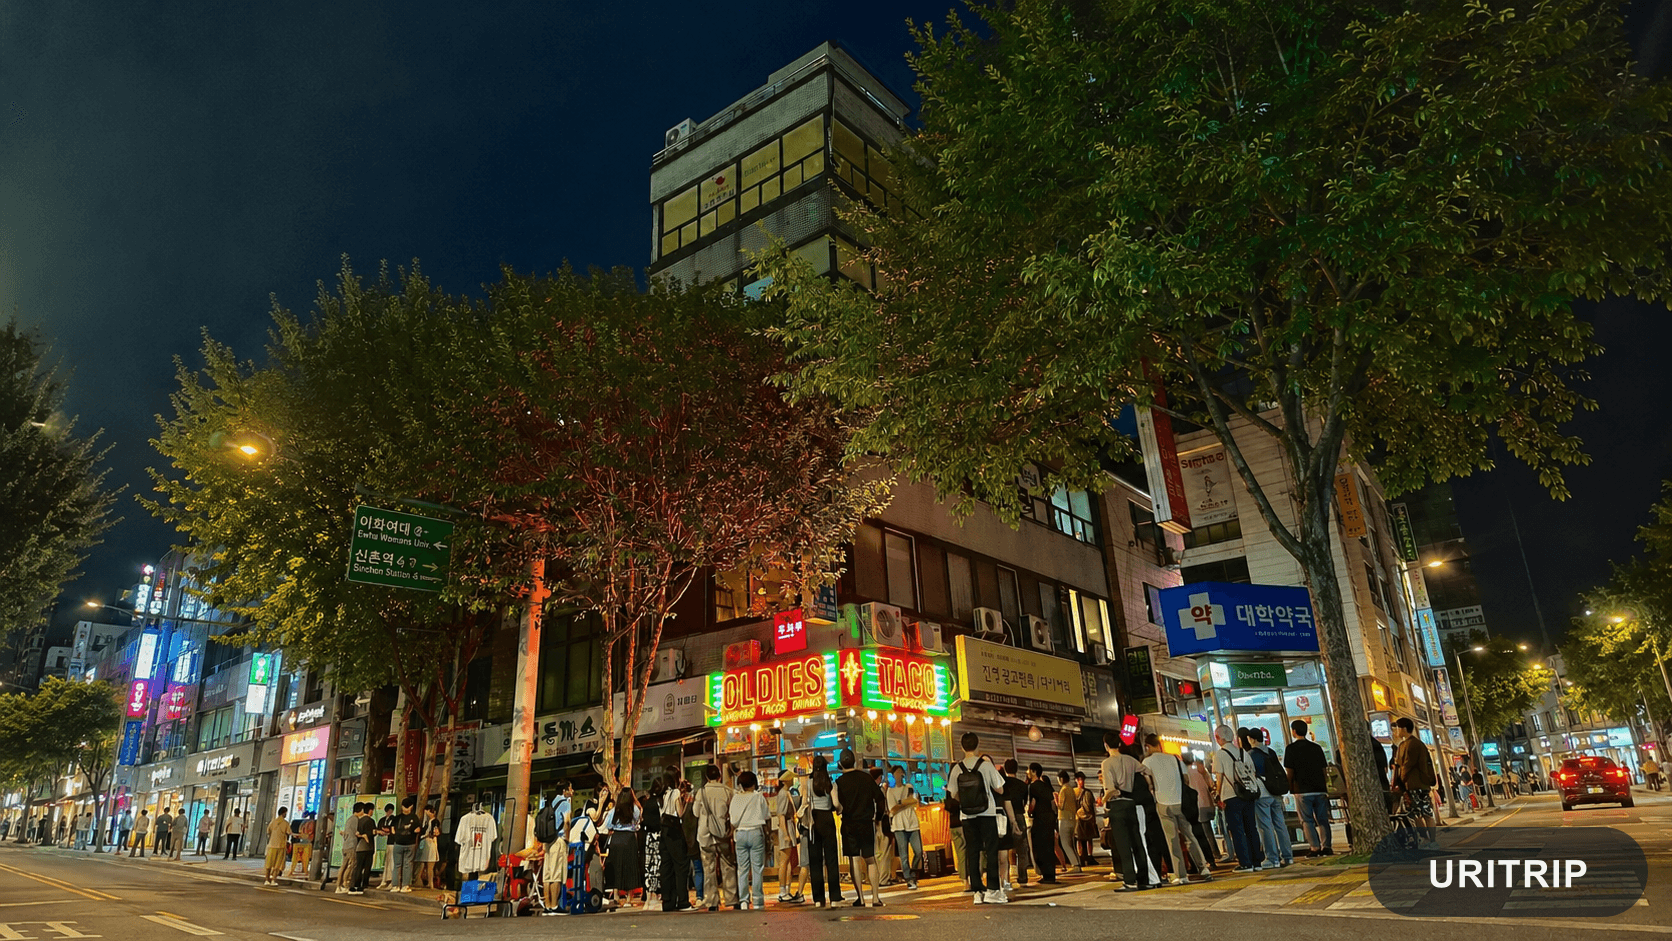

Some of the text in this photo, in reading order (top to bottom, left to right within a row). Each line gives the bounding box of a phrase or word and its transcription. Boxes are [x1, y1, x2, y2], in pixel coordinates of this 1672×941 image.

[360, 516, 411, 536] 이화여대
[380, 532, 412, 546] Womans
[413, 538, 432, 550] Univ.
[355, 549, 395, 567] 신촌역
[1190, 604, 1213, 626] 약
[1235, 604, 1313, 629] 대학약국
[722, 653, 937, 711] OLDIES TACO
